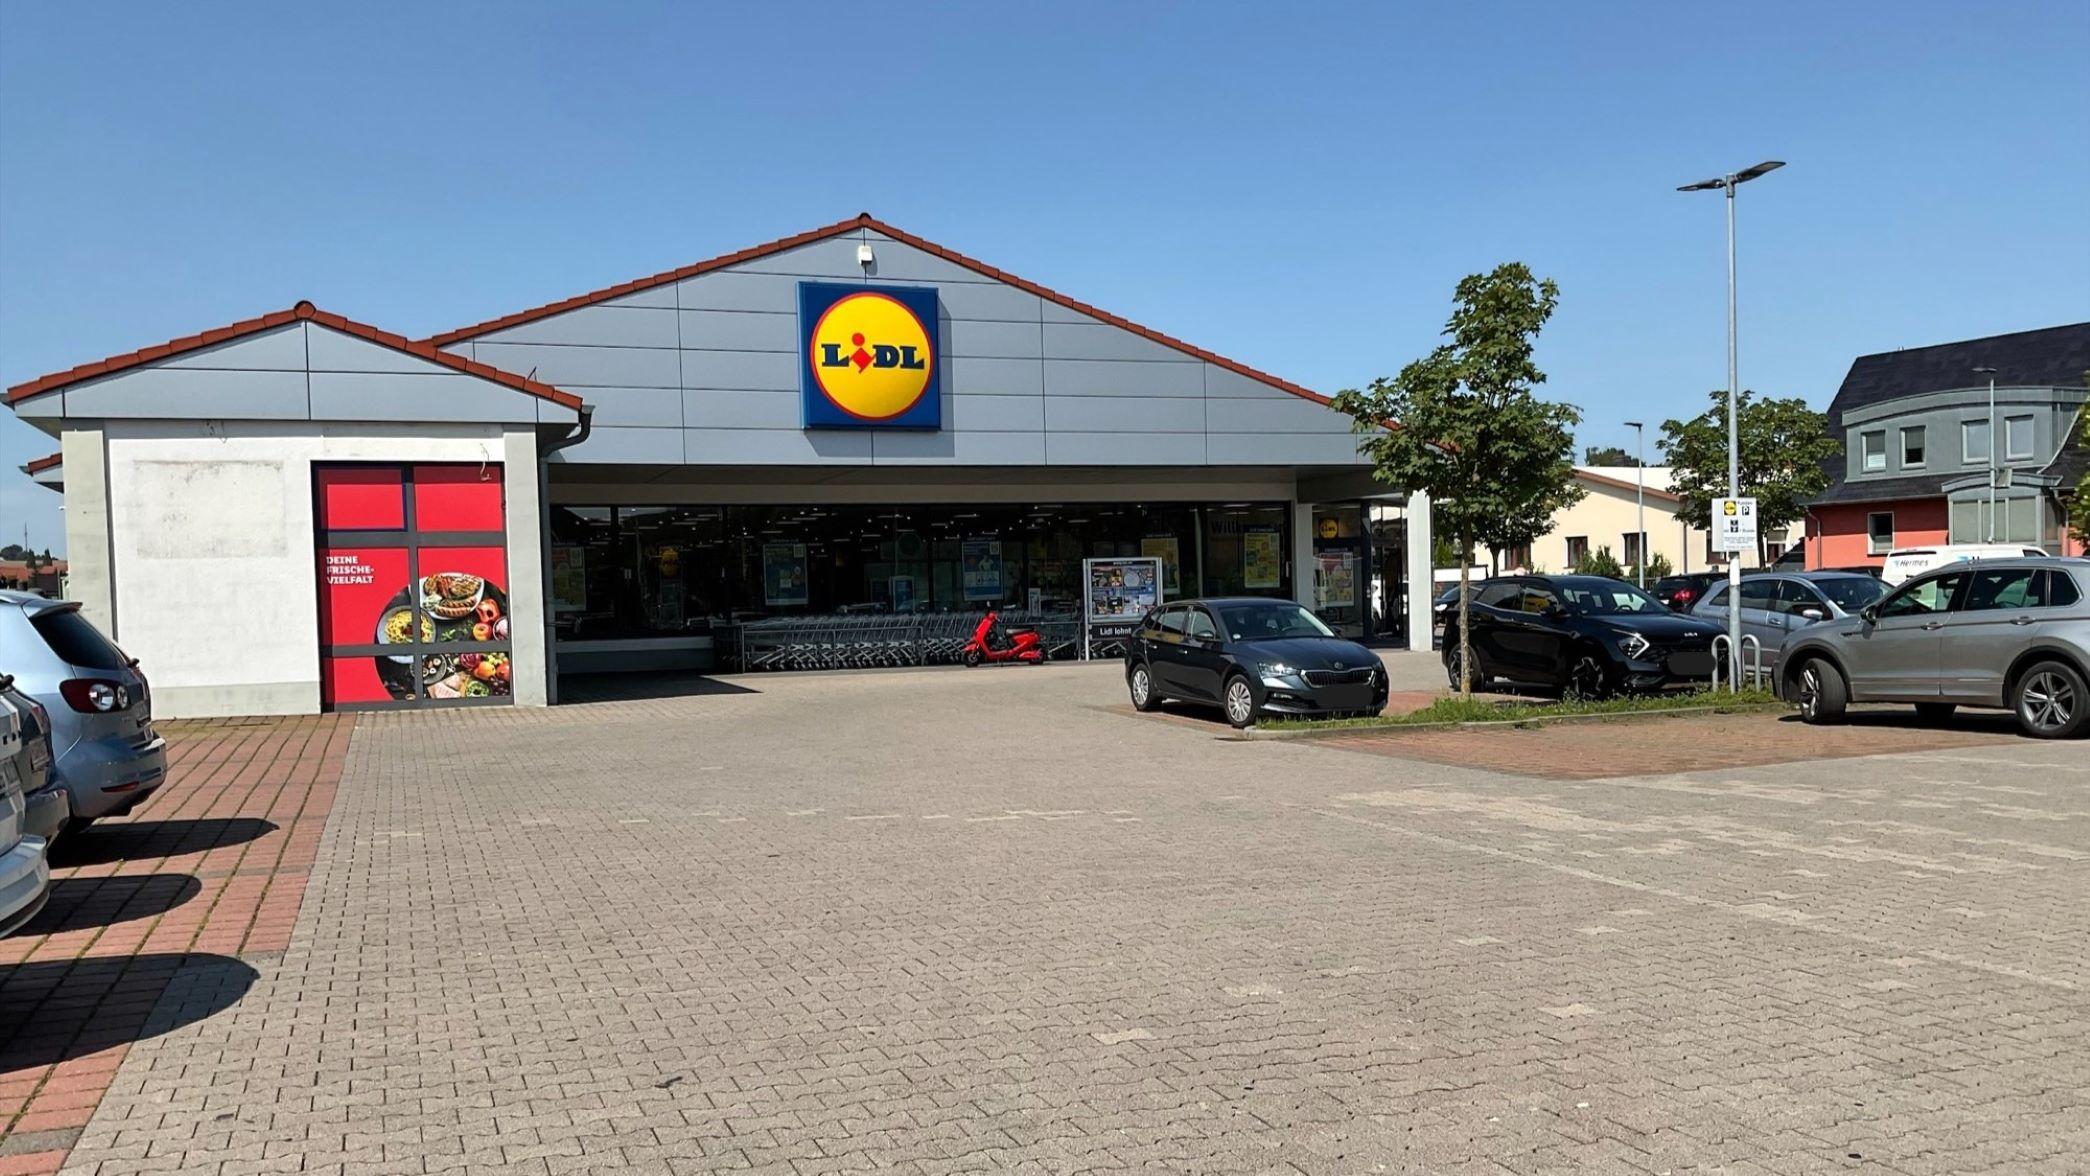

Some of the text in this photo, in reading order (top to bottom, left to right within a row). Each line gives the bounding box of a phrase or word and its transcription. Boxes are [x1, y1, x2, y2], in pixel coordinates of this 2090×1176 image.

[326, 556, 358, 564] DEINE
[1900, 559, 1929, 567] Hermes
[326, 565, 375, 574] FRISCHE-
[326, 575, 374, 585] VIELFALT
[1100, 627, 1132, 635] Lidl lohnt
